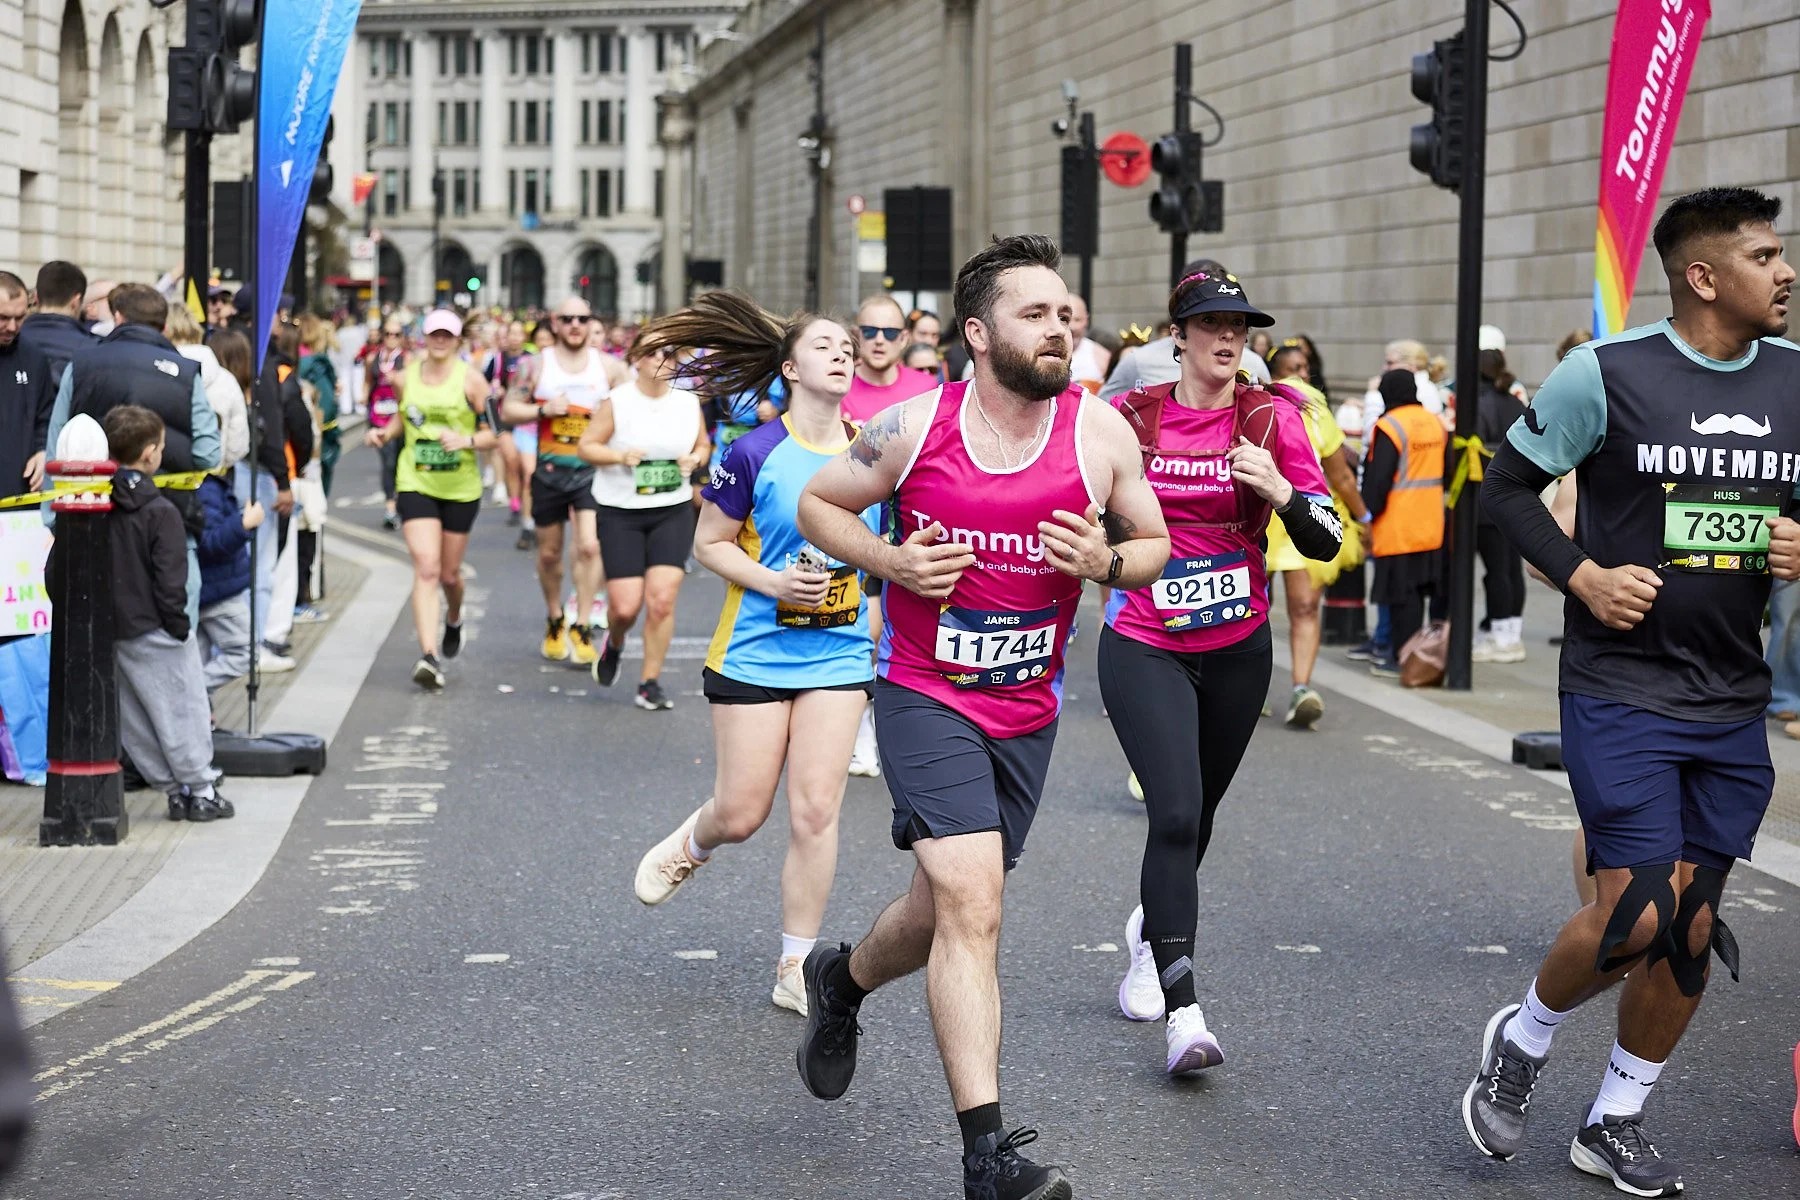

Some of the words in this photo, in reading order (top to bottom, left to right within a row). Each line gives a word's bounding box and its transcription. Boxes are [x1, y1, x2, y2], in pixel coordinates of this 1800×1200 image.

[1643, 112, 1667, 181] pregnancy
[1661, 85, 1673, 112] and
[1668, 53, 1683, 87] baby
[1678, 8, 1694, 51] charity
[1150, 455, 1231, 483] ommy
[1187, 483, 1203, 491] and
[1203, 484, 1224, 493] baby
[1713, 490, 1741, 501] HUSS
[911, 509, 1046, 563] Tommy
[1684, 511, 1764, 543] 7337
[986, 561, 1008, 572] and
[1010, 564, 1037, 576] baby
[1186, 559, 1212, 570] FRAN
[825, 582, 849, 607] 57
[1166, 573, 1236, 605] 9218
[983, 615, 1020, 625] JAMES
[947, 629, 1048, 662] 11744
